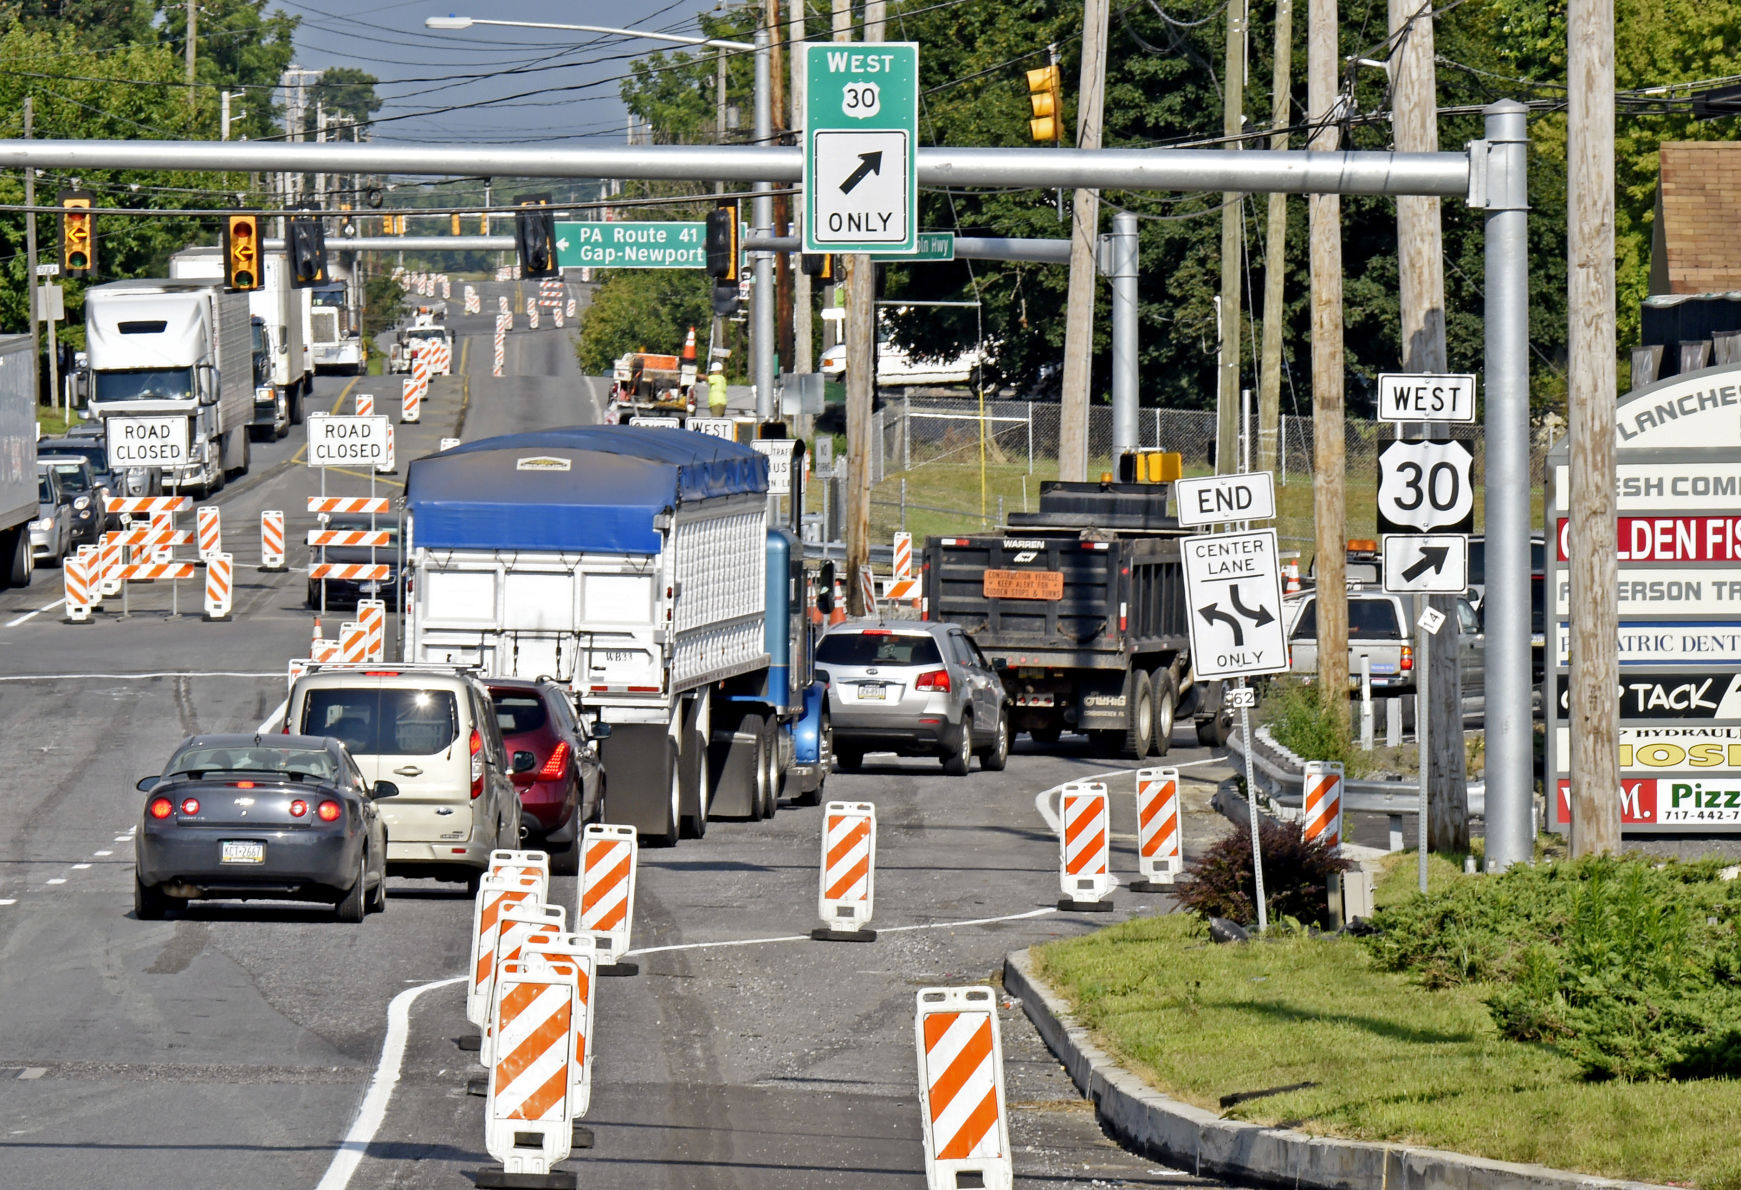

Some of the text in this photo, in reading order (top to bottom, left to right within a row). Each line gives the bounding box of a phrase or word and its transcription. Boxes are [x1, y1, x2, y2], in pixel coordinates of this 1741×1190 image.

[827, 52, 894, 73] WEST
[847, 88, 875, 108] 30
[829, 212, 892, 232] ONLY
[580, 227, 697, 242] PA Route 41
[580, 245, 703, 265] Gap-Newport
[931, 237, 949, 256] Hwy
[1394, 386, 1461, 411] WEST
[1616, 385, 1741, 441] LANCHE
[125, 425, 170, 439] ROAD
[325, 424, 371, 438] ROAD
[116, 444, 180, 459] CLOSED
[316, 443, 380, 458] CLOSED
[1394, 461, 1459, 511] 30
[1671, 476, 1741, 496] COM
[1197, 485, 1252, 513] END
[1003, 540, 1045, 549] WARREN
[1196, 540, 1264, 558] CENTER
[1208, 558, 1255, 575] LANE
[1217, 651, 1264, 667] ONLY
[1234, 692, 1253, 704] 62
[1629, 678, 1717, 712] TACK
[1636, 728, 1741, 738] HYDRAUL
